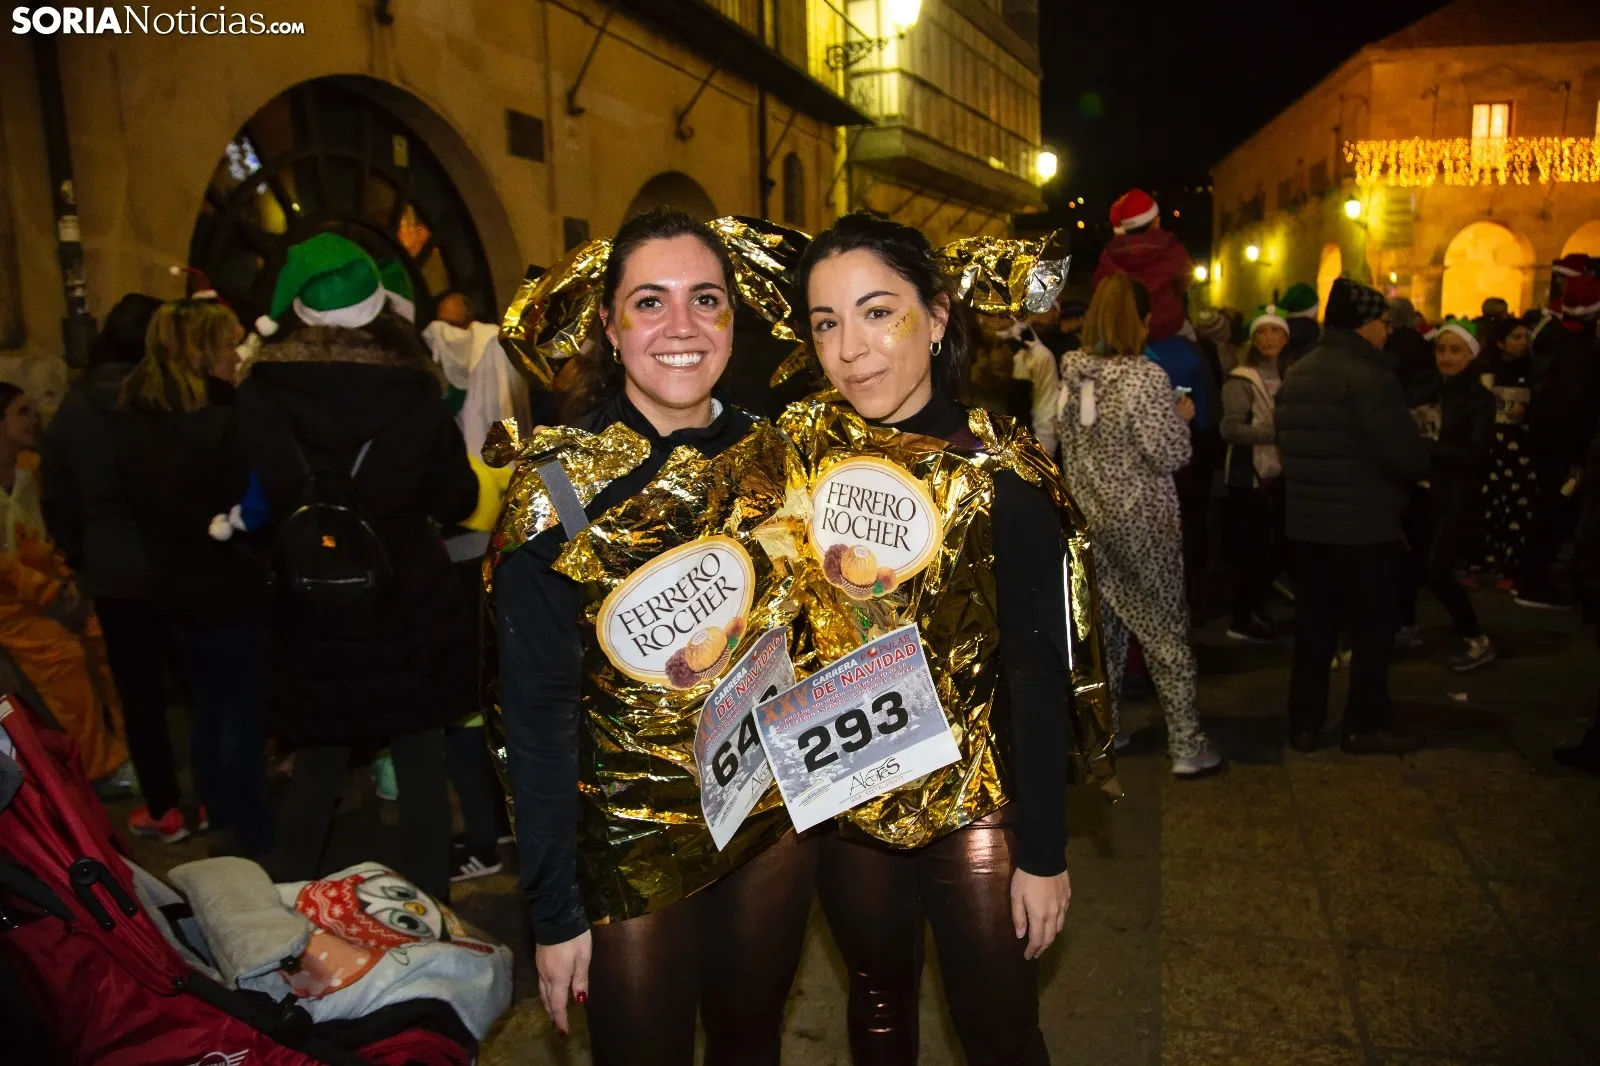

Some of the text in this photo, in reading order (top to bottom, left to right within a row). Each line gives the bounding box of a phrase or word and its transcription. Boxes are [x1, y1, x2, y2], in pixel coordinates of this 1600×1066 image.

[821, 507, 912, 552] ROCHER
[827, 481, 917, 522] FERRERO
[617, 552, 721, 635] FERRERO
[631, 576, 739, 658] ROCHER
[714, 667, 748, 706] CARRERA
[716, 693, 735, 719] DE
[735, 631, 783, 698] NAVIDAD
[812, 679, 838, 701] DE
[840, 643, 918, 688] NAVIDAD
[812, 659, 858, 687] CARRERA
[797, 691, 909, 773] 293
